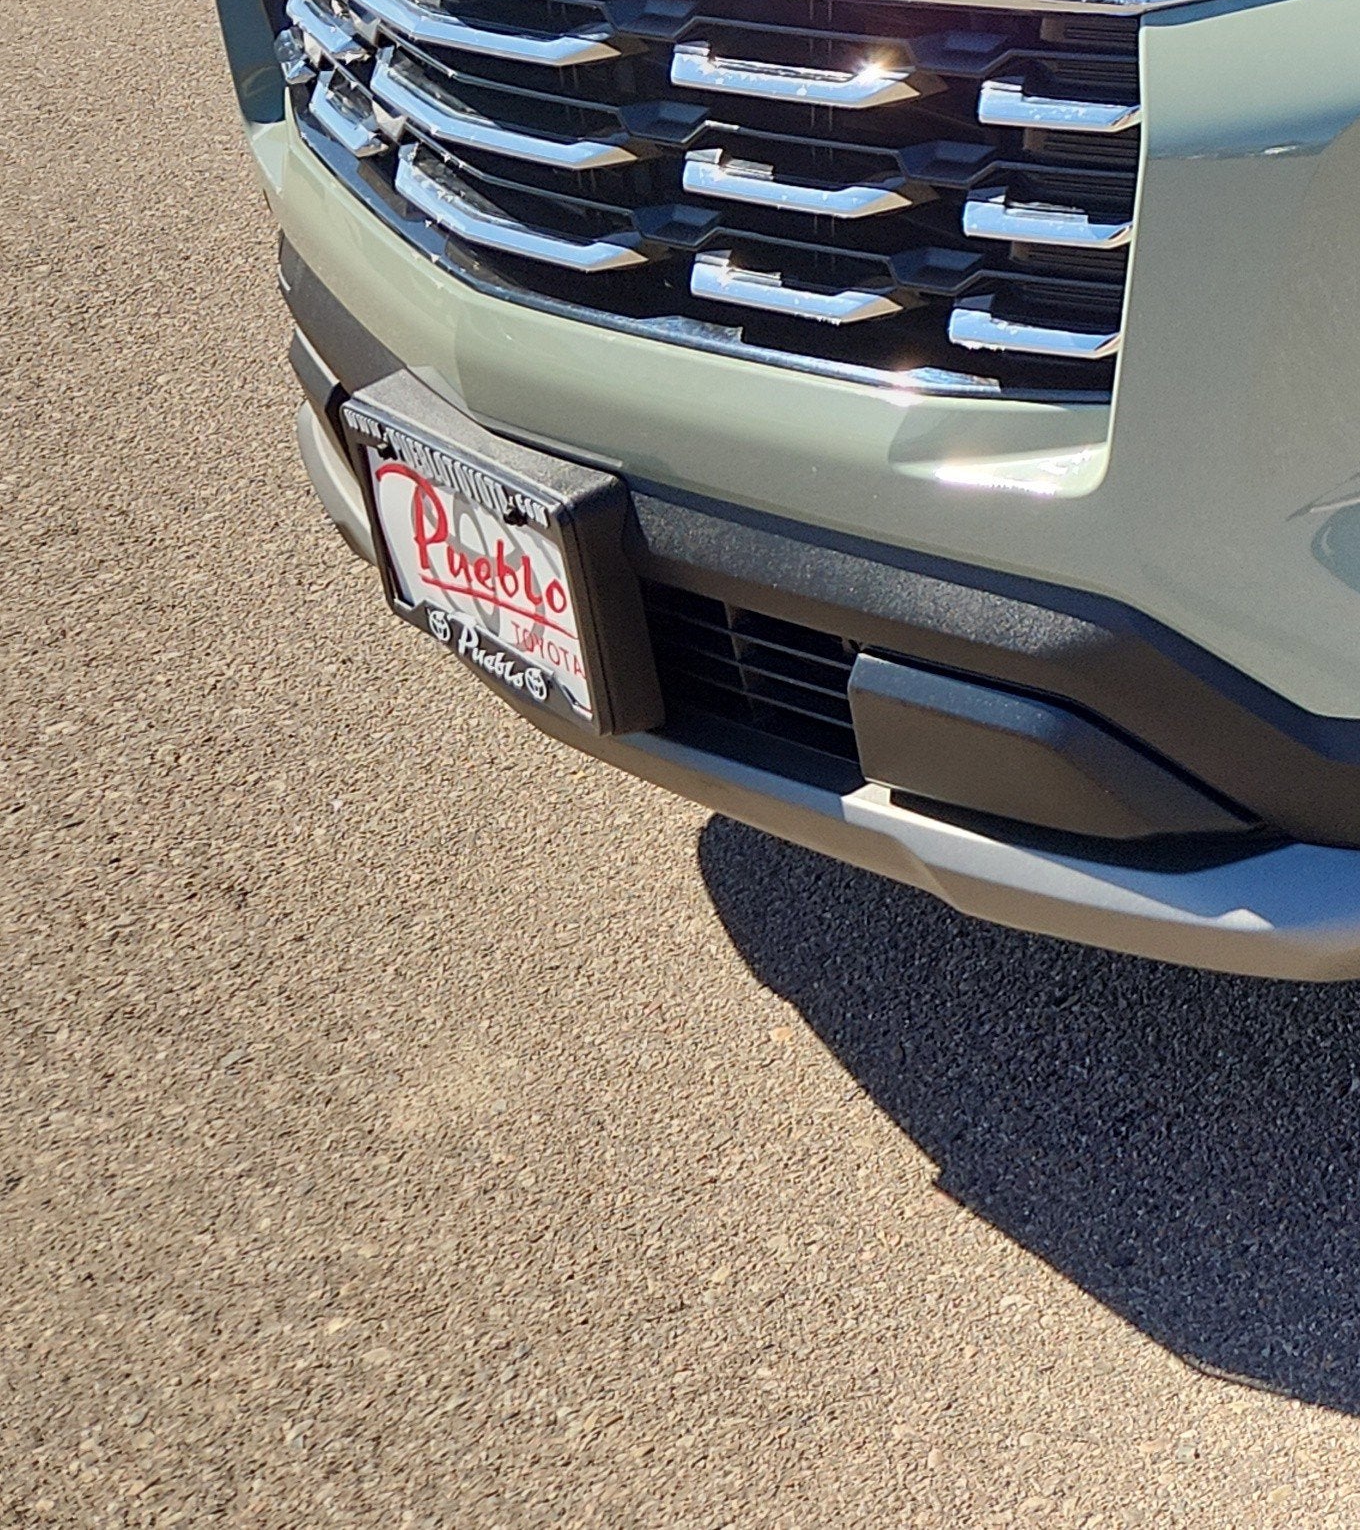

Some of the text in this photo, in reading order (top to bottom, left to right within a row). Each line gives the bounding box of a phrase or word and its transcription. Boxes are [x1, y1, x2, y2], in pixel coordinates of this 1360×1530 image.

[376, 463, 566, 614] Pueblo
[450, 612, 524, 687] Pueblo
[511, 621, 585, 679] TOYOTA
